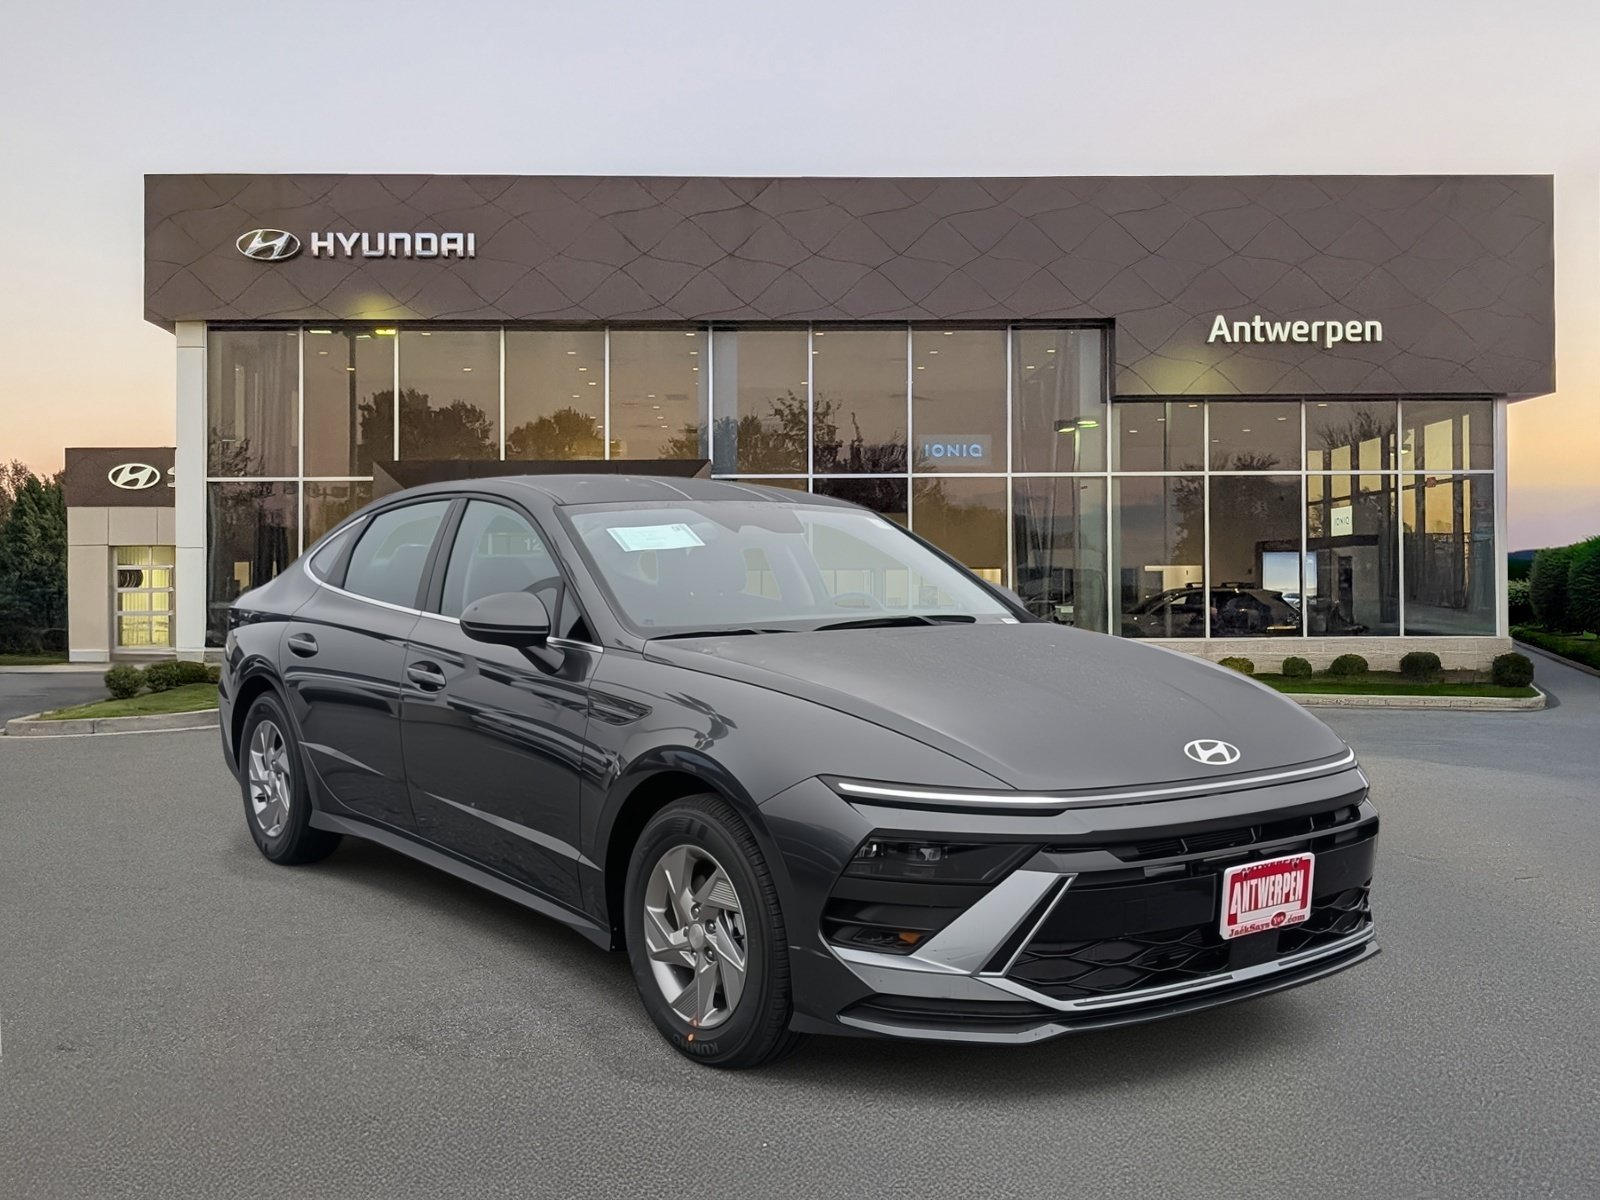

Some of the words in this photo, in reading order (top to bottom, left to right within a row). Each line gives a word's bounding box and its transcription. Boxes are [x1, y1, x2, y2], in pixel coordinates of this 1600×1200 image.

[311, 232, 475, 257] HYUNDAI
[1207, 315, 1382, 348] Antwerpen
[924, 443, 982, 457] IONIQ
[1229, 869, 1304, 914] ANTWERPEN
[672, 1033, 719, 1054] KUMHO
